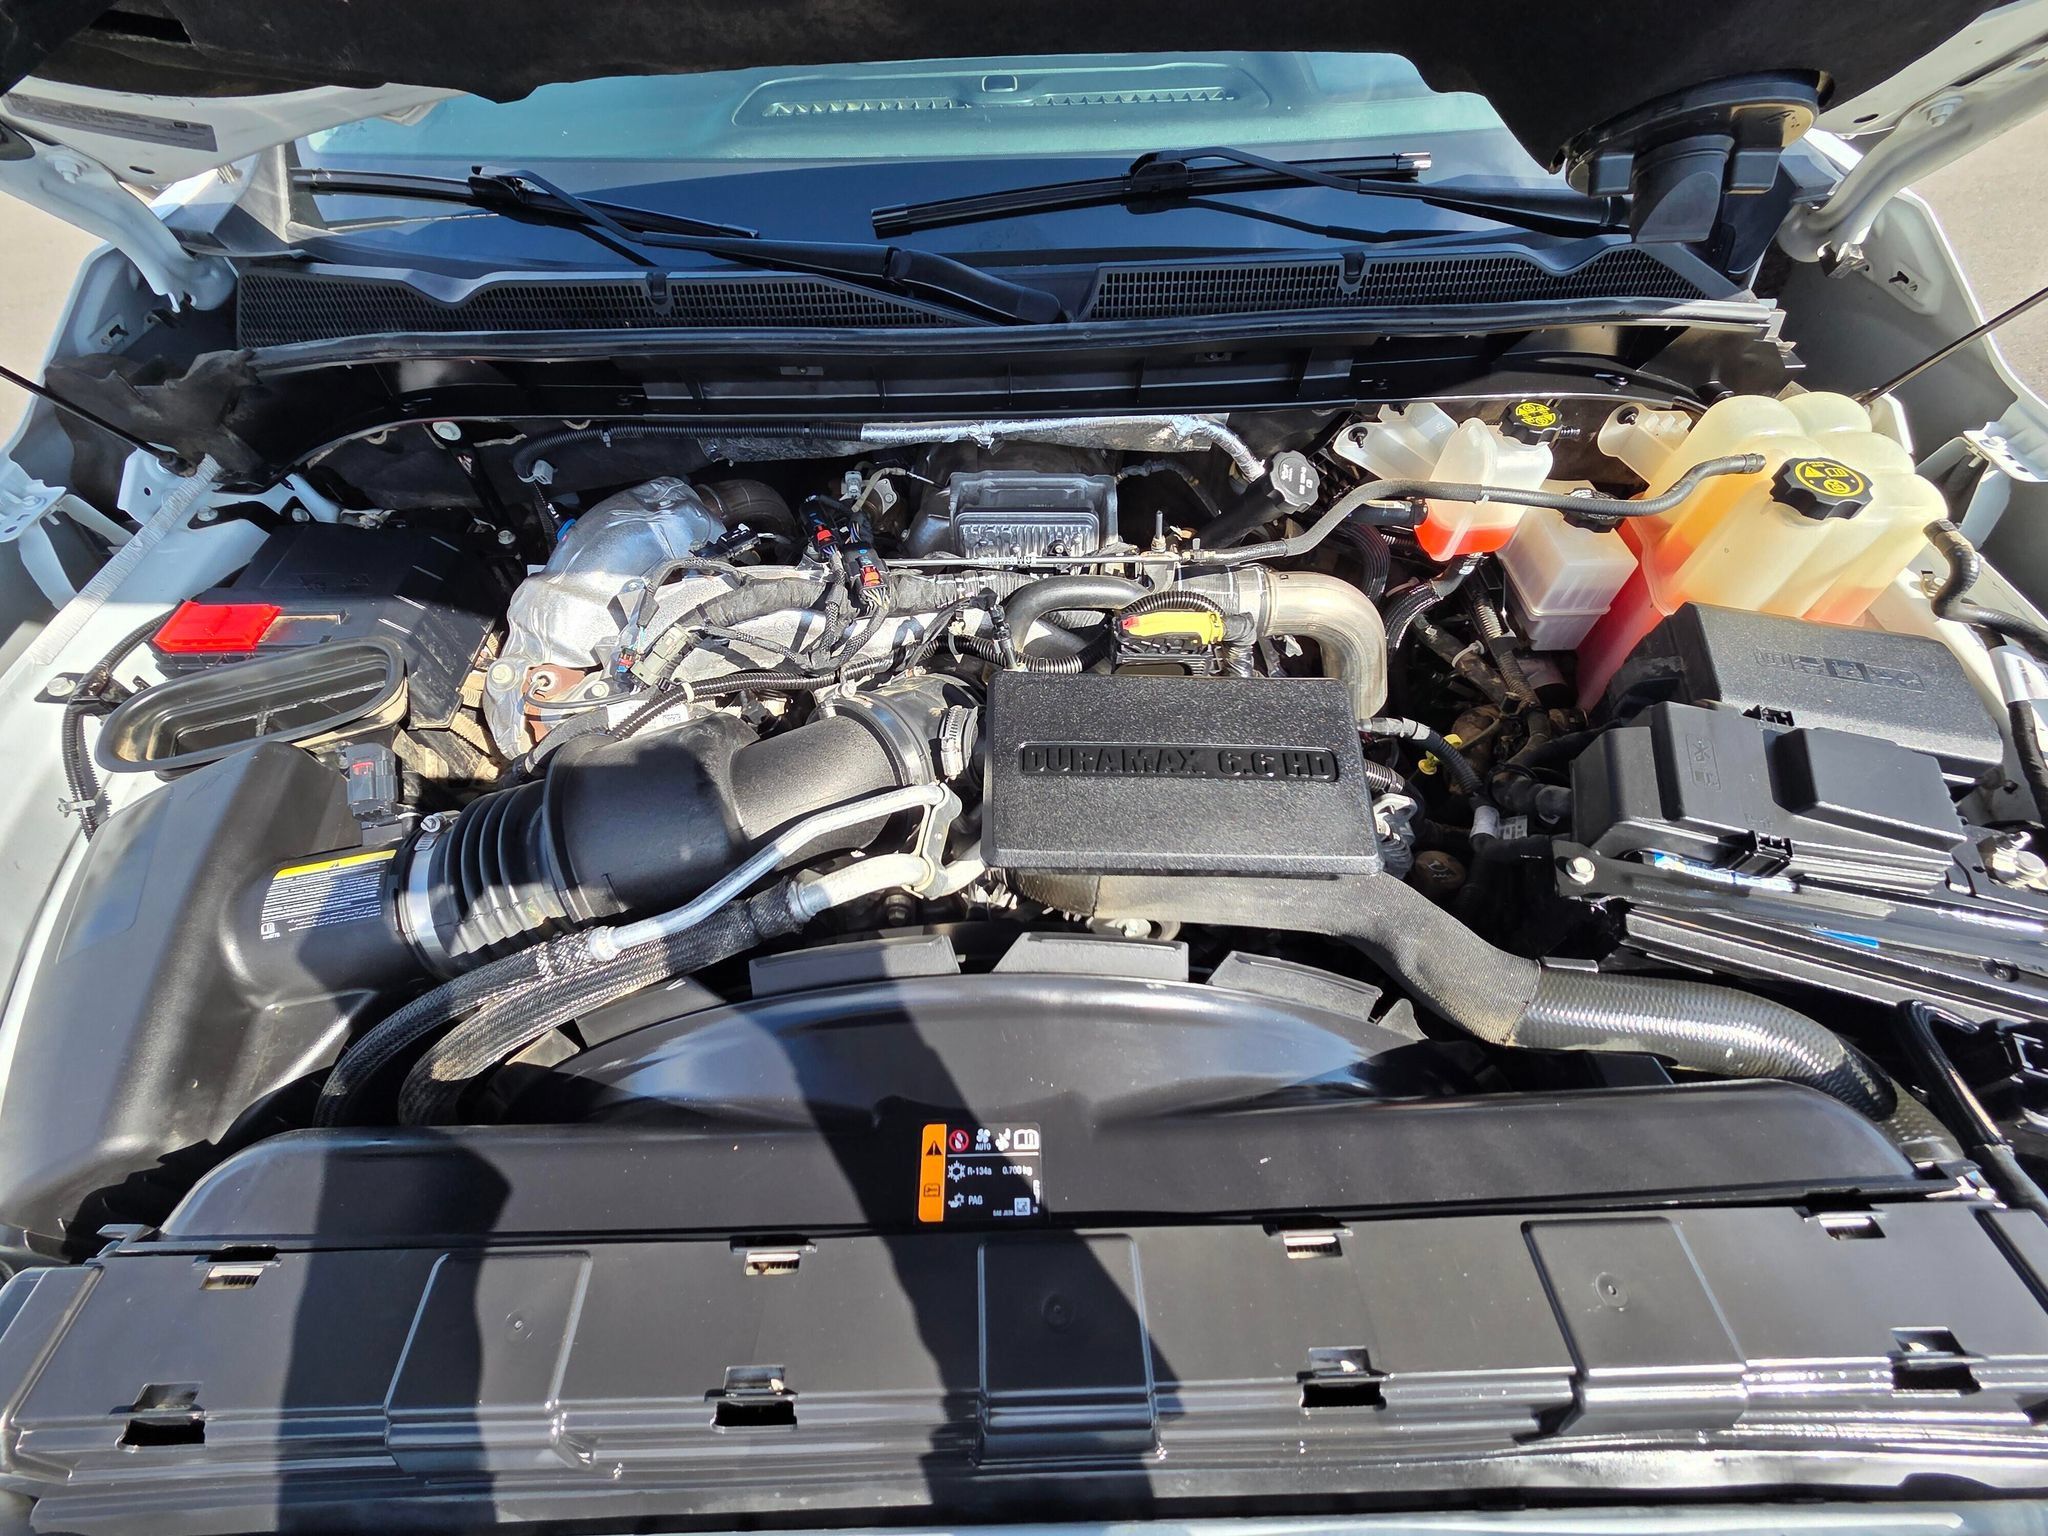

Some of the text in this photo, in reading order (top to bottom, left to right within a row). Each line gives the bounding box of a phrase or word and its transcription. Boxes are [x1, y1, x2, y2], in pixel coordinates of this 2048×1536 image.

[1021, 748, 1335, 779] DURAMAX 6.6 HD
[967, 1166, 992, 1175] R-134a
